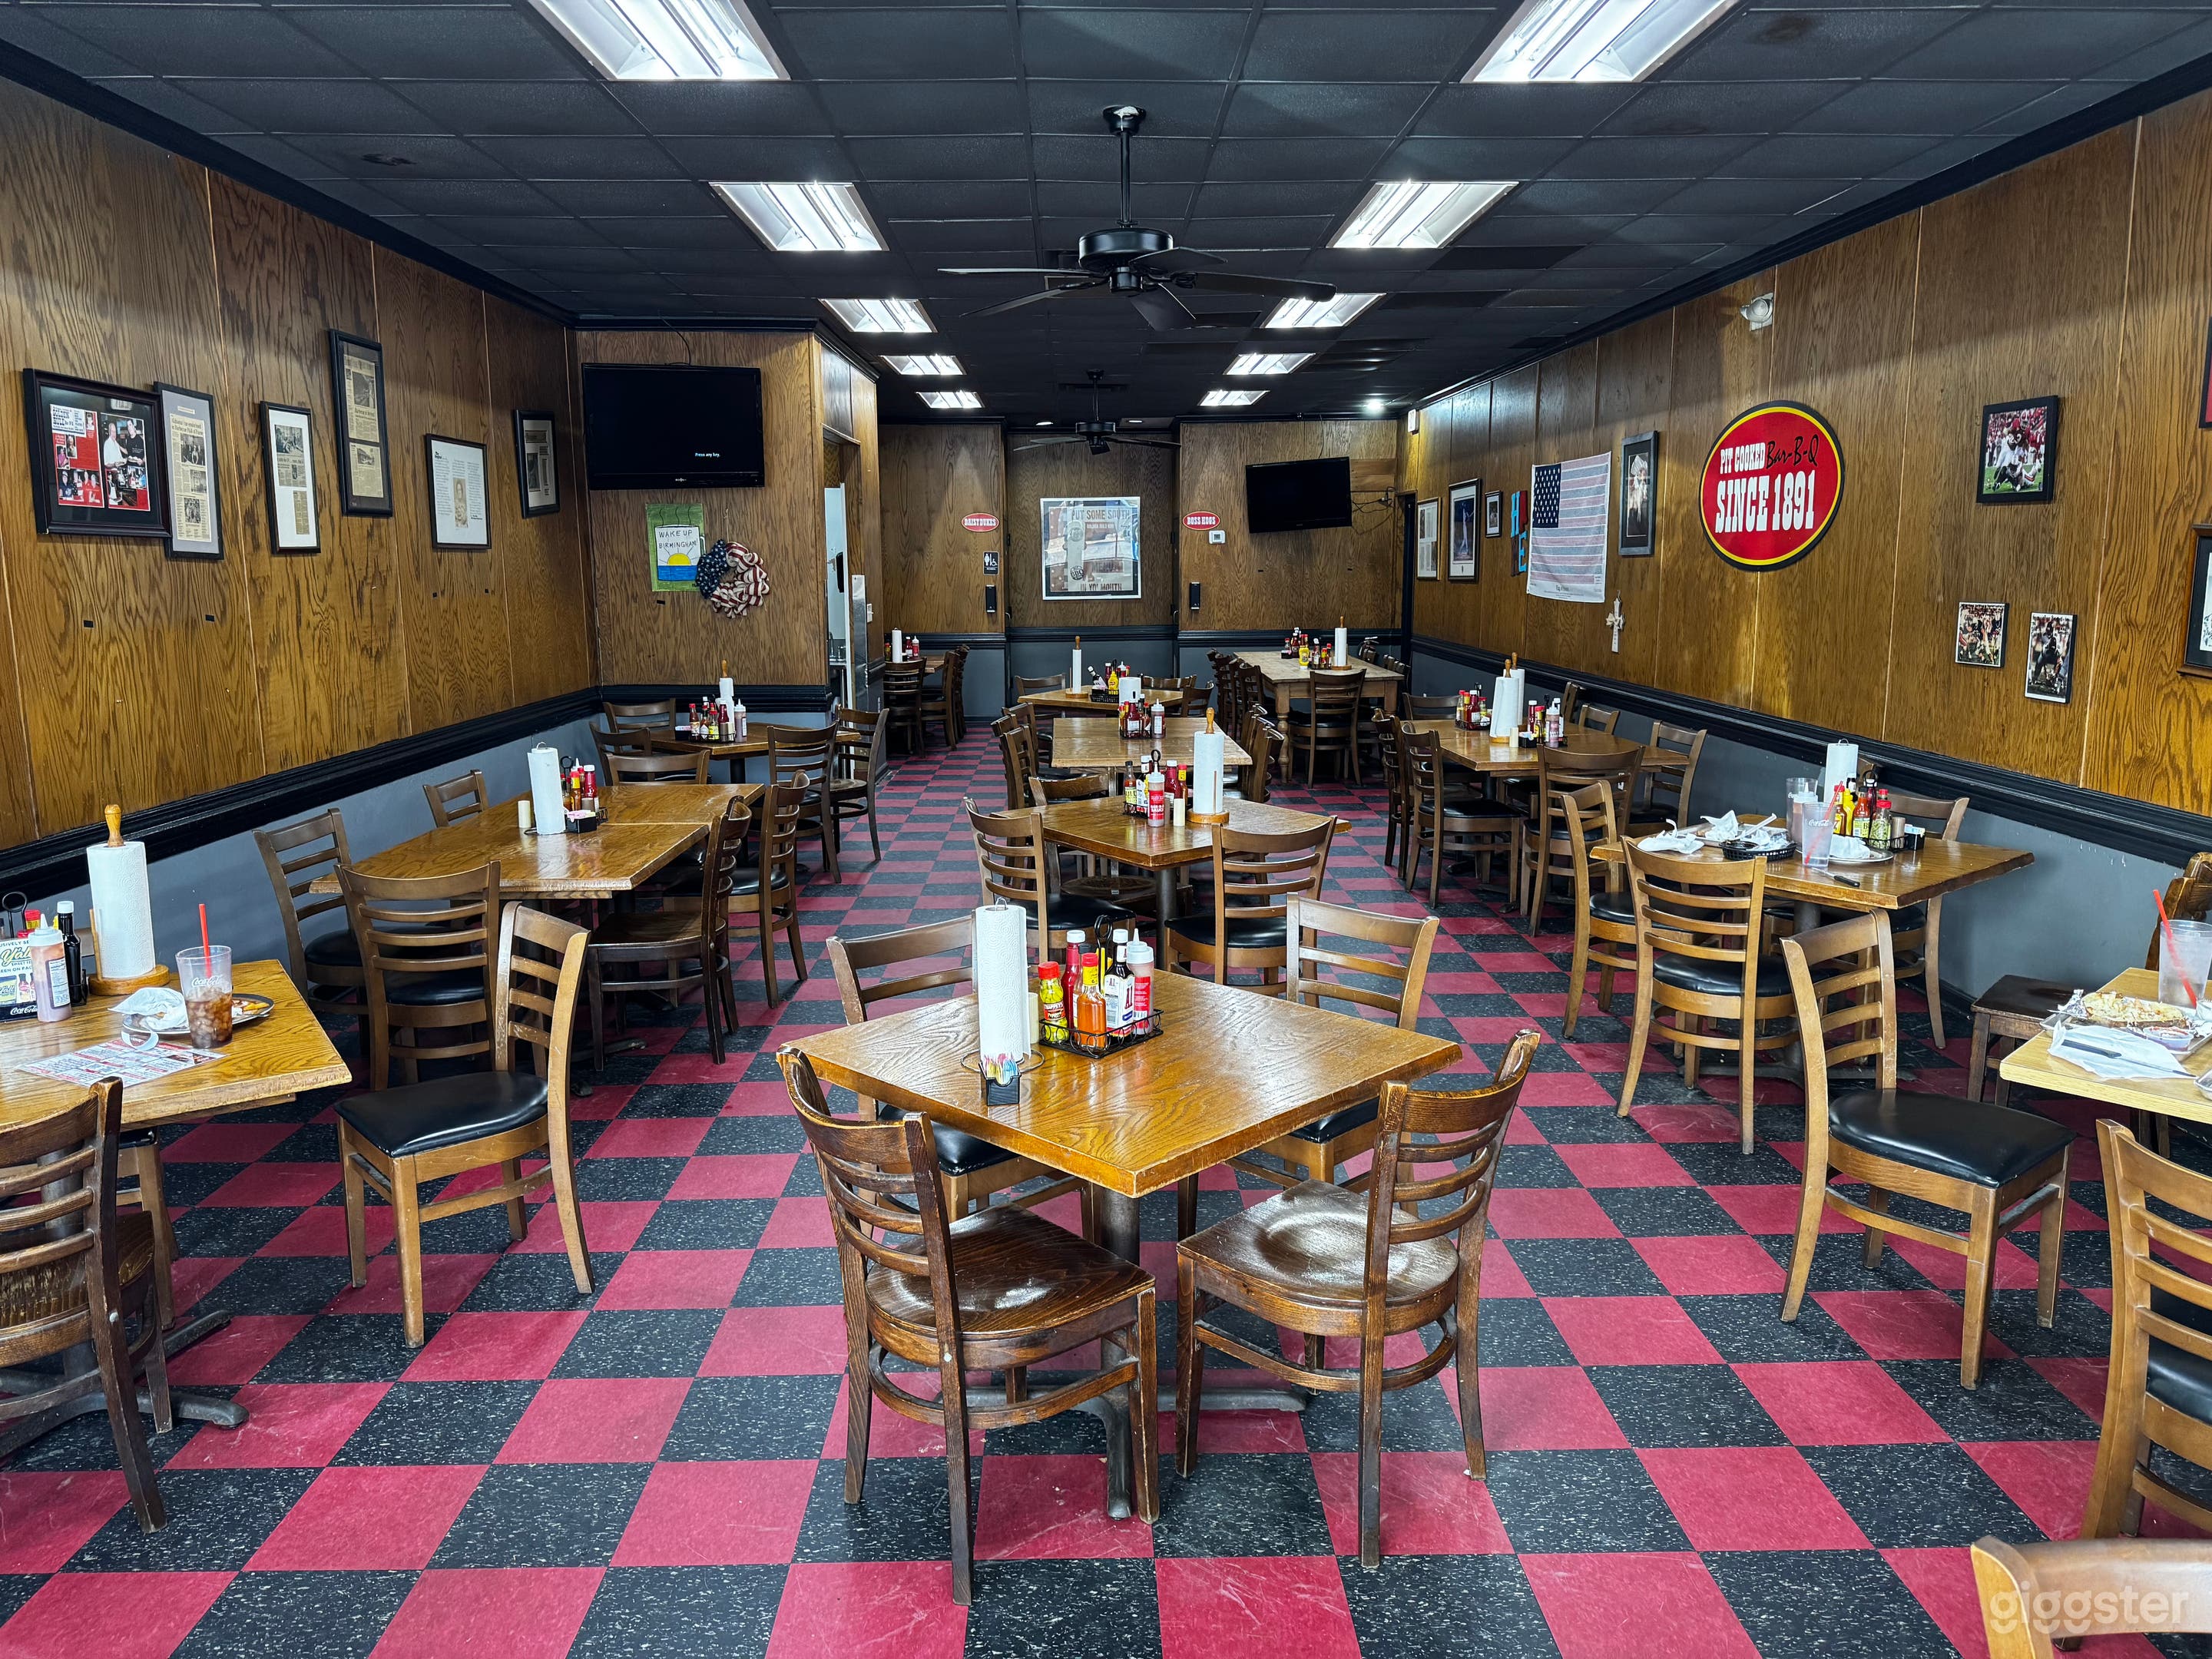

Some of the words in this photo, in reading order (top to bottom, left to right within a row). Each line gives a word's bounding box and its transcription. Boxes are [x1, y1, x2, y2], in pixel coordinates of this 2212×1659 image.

[1720, 448, 1734, 474] PIT
[1734, 442, 1766, 472] COOKED
[1767, 434, 1819, 469] Bar-B-Q
[1715, 475, 1770, 533] SINCE
[1772, 469, 1816, 531] 1891
[1071, 509, 1084, 520] PUT
[1087, 510, 1105, 520] SOME
[1108, 509, 1130, 520] SOUTH
[979, 518, 996, 526] DUKES
[1187, 516, 1200, 525] BOSS
[1201, 516, 1216, 525] HOGS
[658, 538, 698, 549] BIRMINGHAM!
[191, 975, 223, 988] Coca-Cola
[10, 1005, 38, 1015] Coca-Cola
